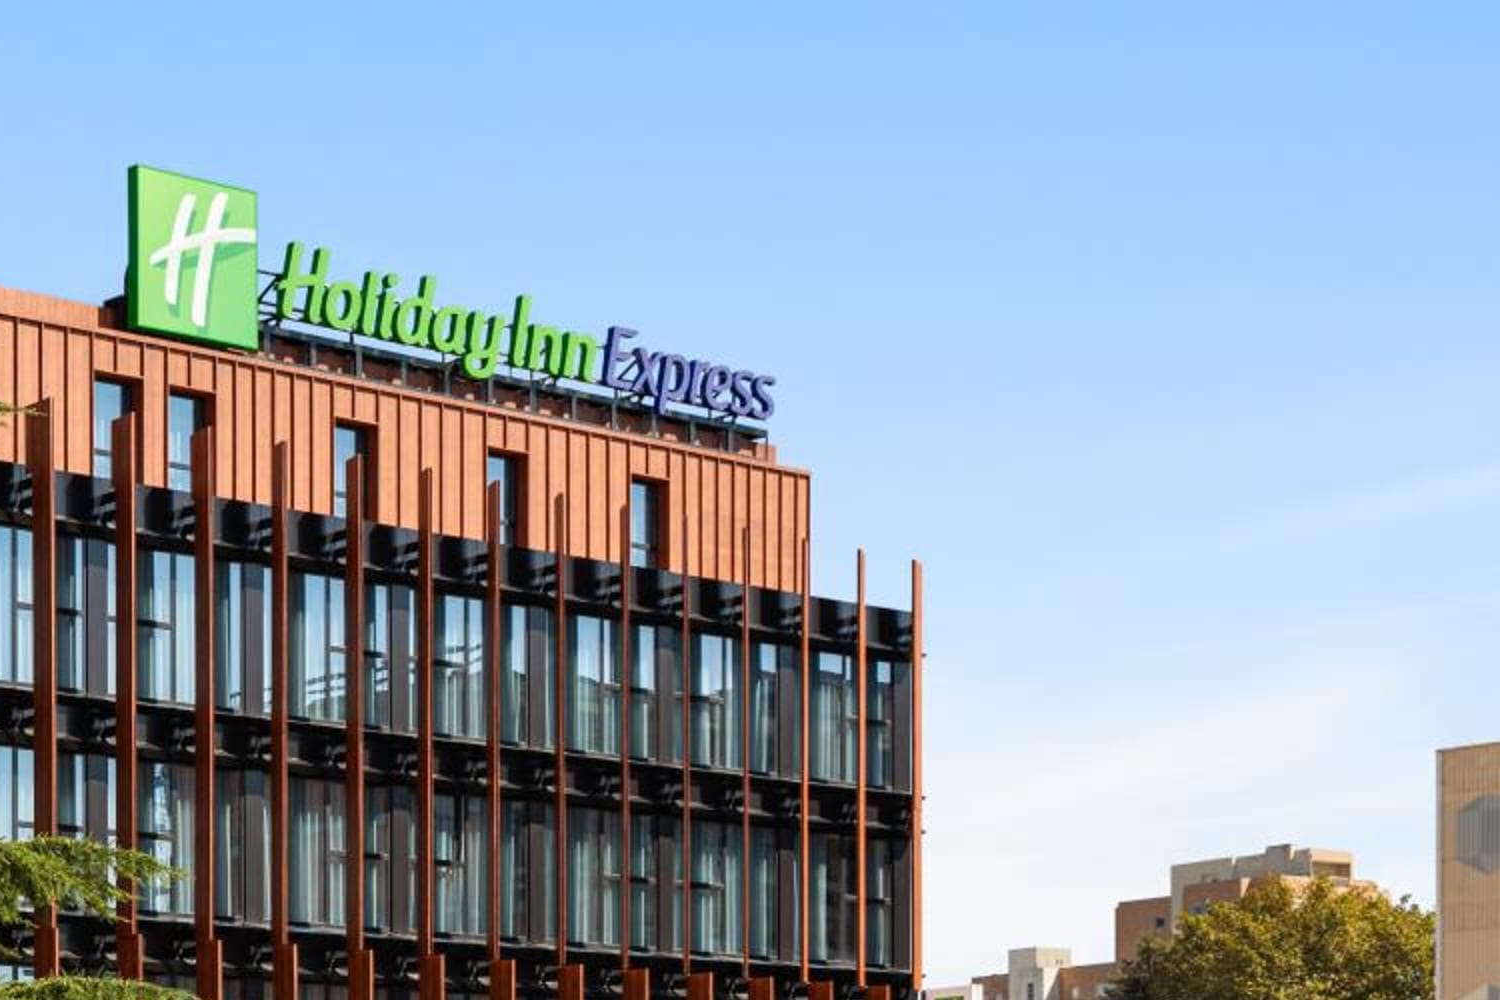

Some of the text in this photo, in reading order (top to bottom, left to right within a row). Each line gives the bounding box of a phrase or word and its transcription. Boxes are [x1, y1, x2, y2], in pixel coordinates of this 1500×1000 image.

[276, 241, 776, 420] Holiday Inn Express
